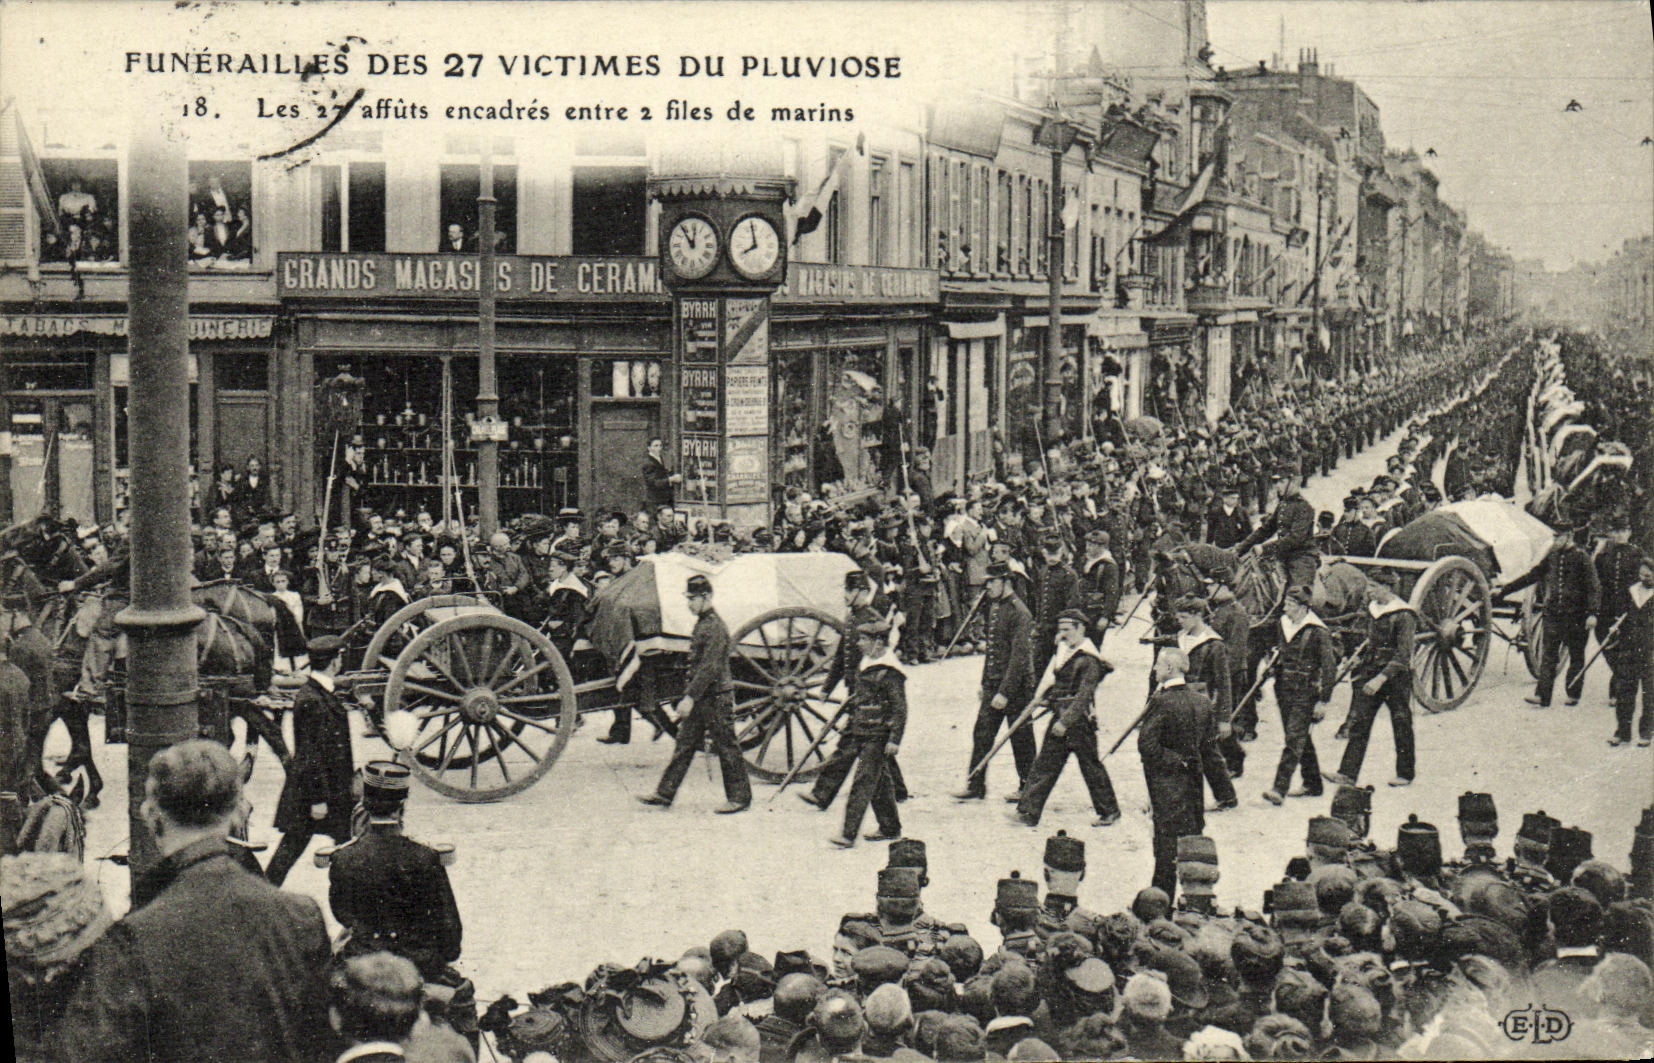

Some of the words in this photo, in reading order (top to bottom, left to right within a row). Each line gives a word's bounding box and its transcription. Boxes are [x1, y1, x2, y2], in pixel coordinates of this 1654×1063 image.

[283, 258, 377, 290] GRANDS
[395, 258, 512, 292] MAGASIS
[530, 262, 559, 294] DE
[682, 301, 717, 319] BYRRH
[682, 370, 717, 388] BYRRH
[682, 439, 717, 457] BYRRH
